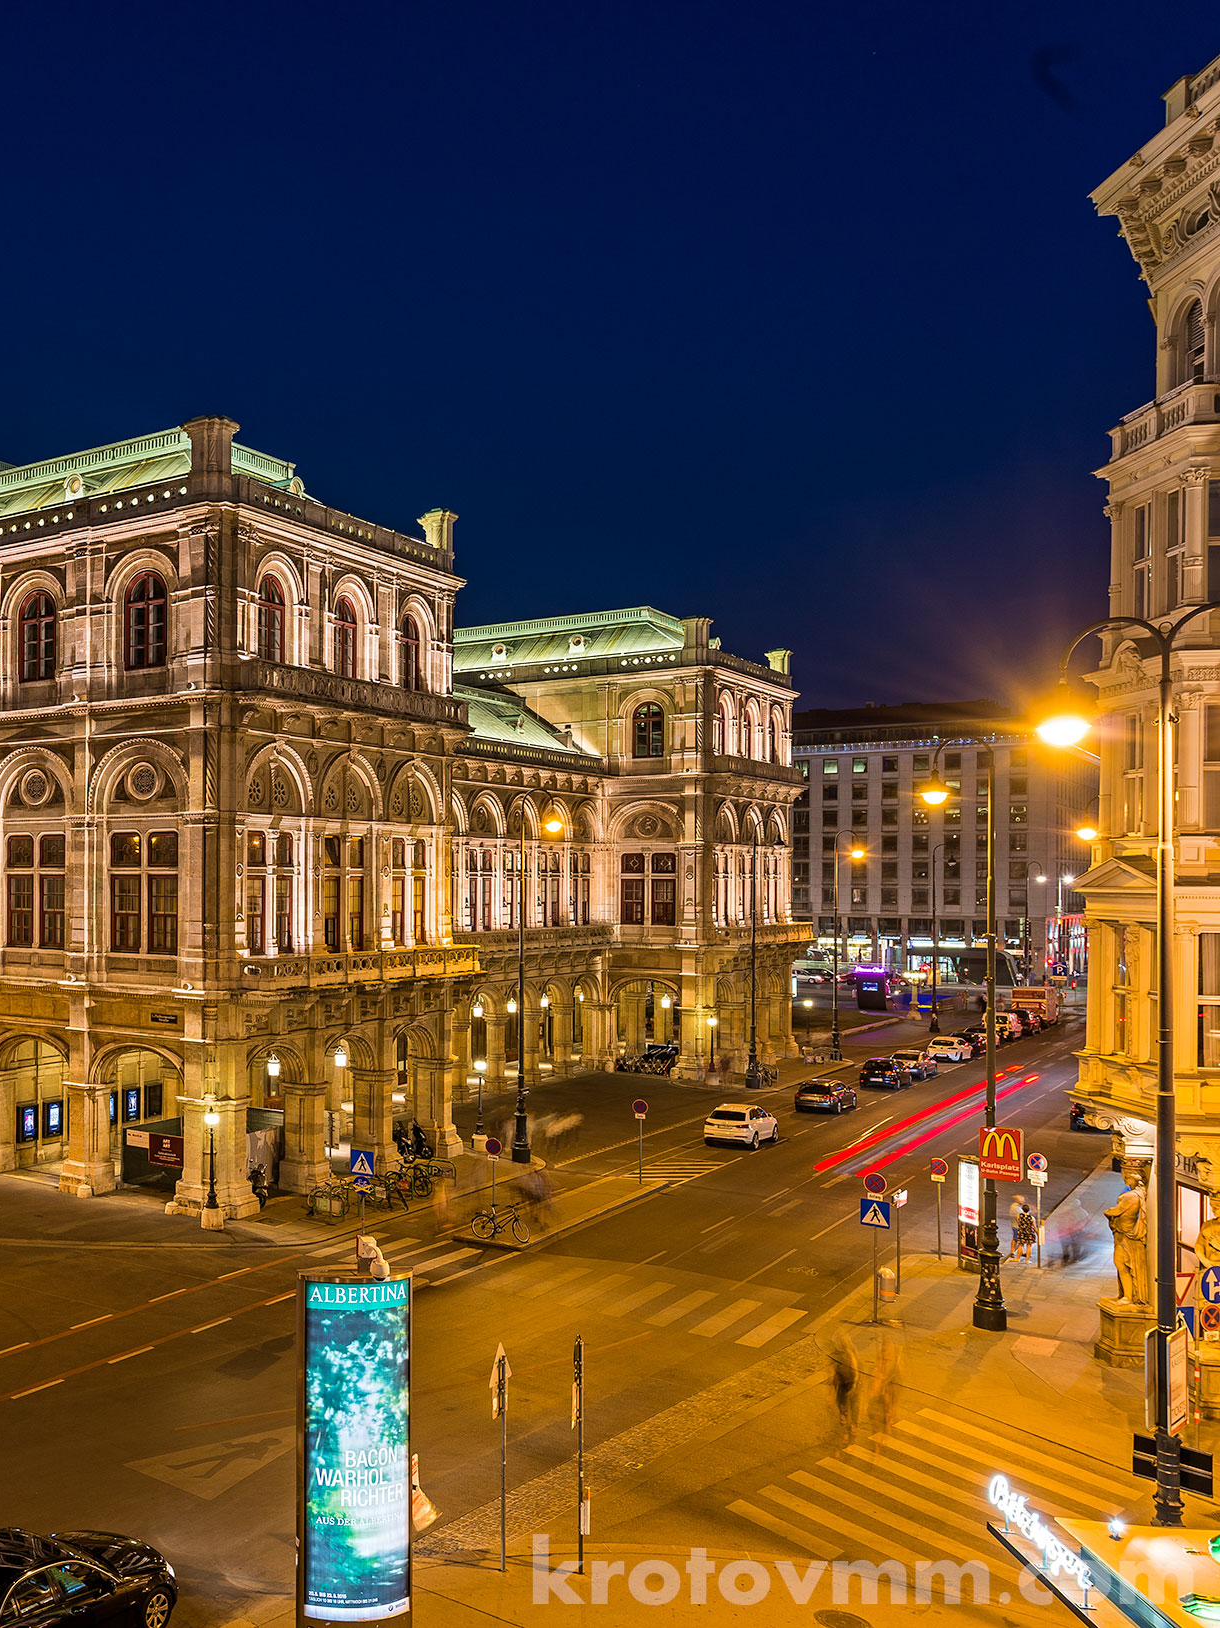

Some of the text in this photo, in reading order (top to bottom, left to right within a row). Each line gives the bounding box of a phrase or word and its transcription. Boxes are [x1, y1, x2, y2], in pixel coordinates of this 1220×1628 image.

[980, 1161, 1020, 1172] Karlsplatz
[309, 1283, 407, 1304] ALBERTINA
[345, 1446, 397, 1468] BACON
[315, 1468, 387, 1487] WARHOL
[340, 1482, 403, 1507] RICHTER
[315, 1511, 405, 1526] AUS DER ALBERTINA
